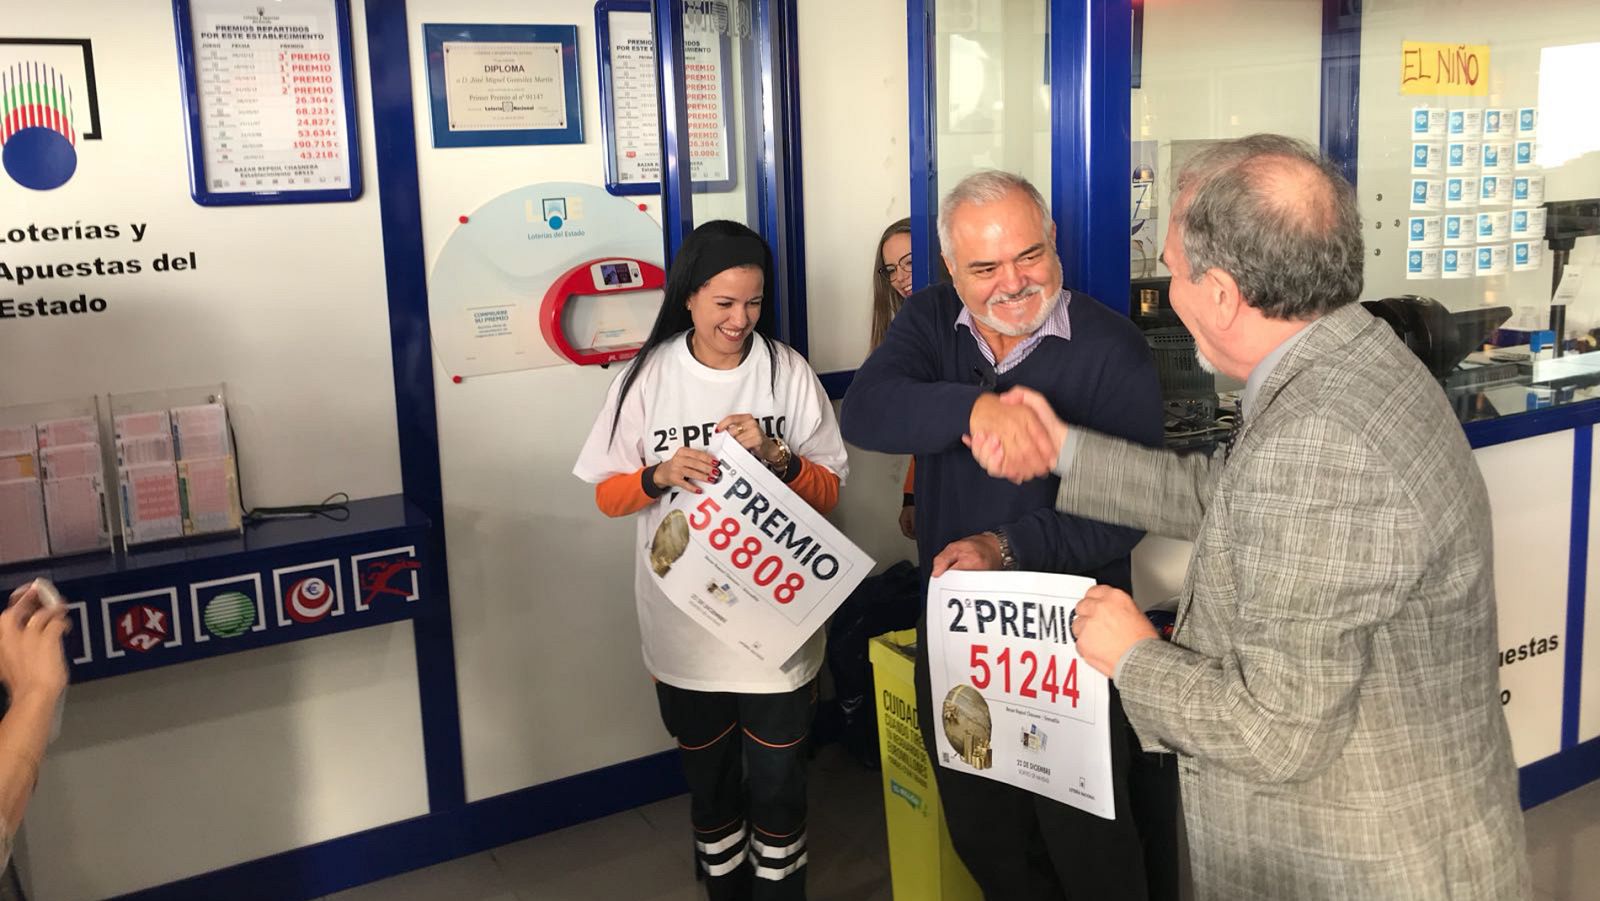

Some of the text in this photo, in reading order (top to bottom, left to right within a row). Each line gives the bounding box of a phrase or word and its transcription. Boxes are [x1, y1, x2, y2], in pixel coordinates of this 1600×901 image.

[290, 53, 331, 61] PREMIO
[292, 64, 332, 72] PREMIO
[685, 64, 716, 72] PREMIO
[1402, 45, 1480, 87] EL NIÑO
[293, 75, 333, 83] PREMIO
[294, 86, 334, 94] PREMIO
[686, 83, 717, 91] PREMIO
[686, 93, 718, 101] PREMIO
[688, 112, 718, 120] PREMIO
[688, 131, 719, 139] PREMIO
[0, 220, 147, 243] oterías y
[0, 252, 197, 285] Apuestas del
[0, 293, 107, 319] Estado
[723, 476, 839, 581] PREMIO
[689, 497, 805, 605] 58808
[947, 598, 972, 633] 2º
[1499, 634, 1559, 668] estas
[969, 644, 1080, 708] 51244
[883, 689, 919, 730] CUIDAD
